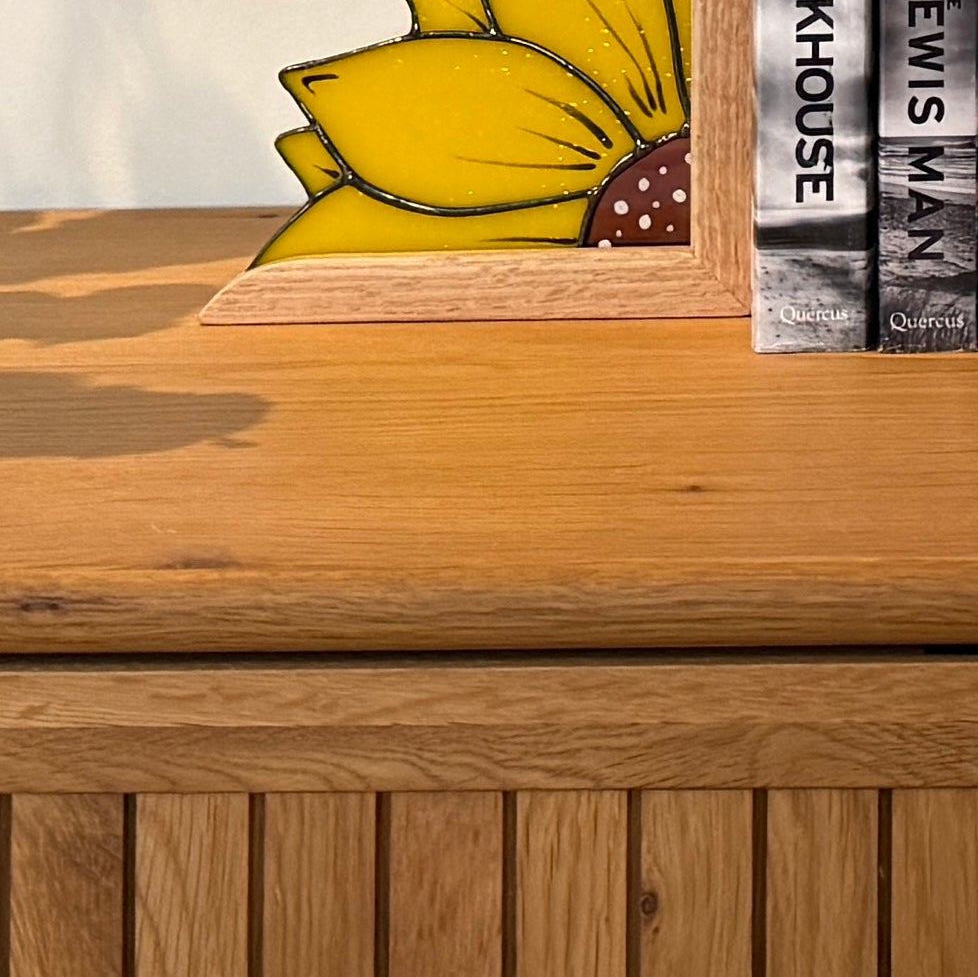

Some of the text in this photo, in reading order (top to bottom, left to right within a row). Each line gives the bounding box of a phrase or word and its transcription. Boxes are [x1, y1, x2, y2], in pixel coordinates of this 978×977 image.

[907, 145, 945, 261] MAN
[779, 305, 849, 326] Quercus
[889, 312, 966, 332] Quercus
